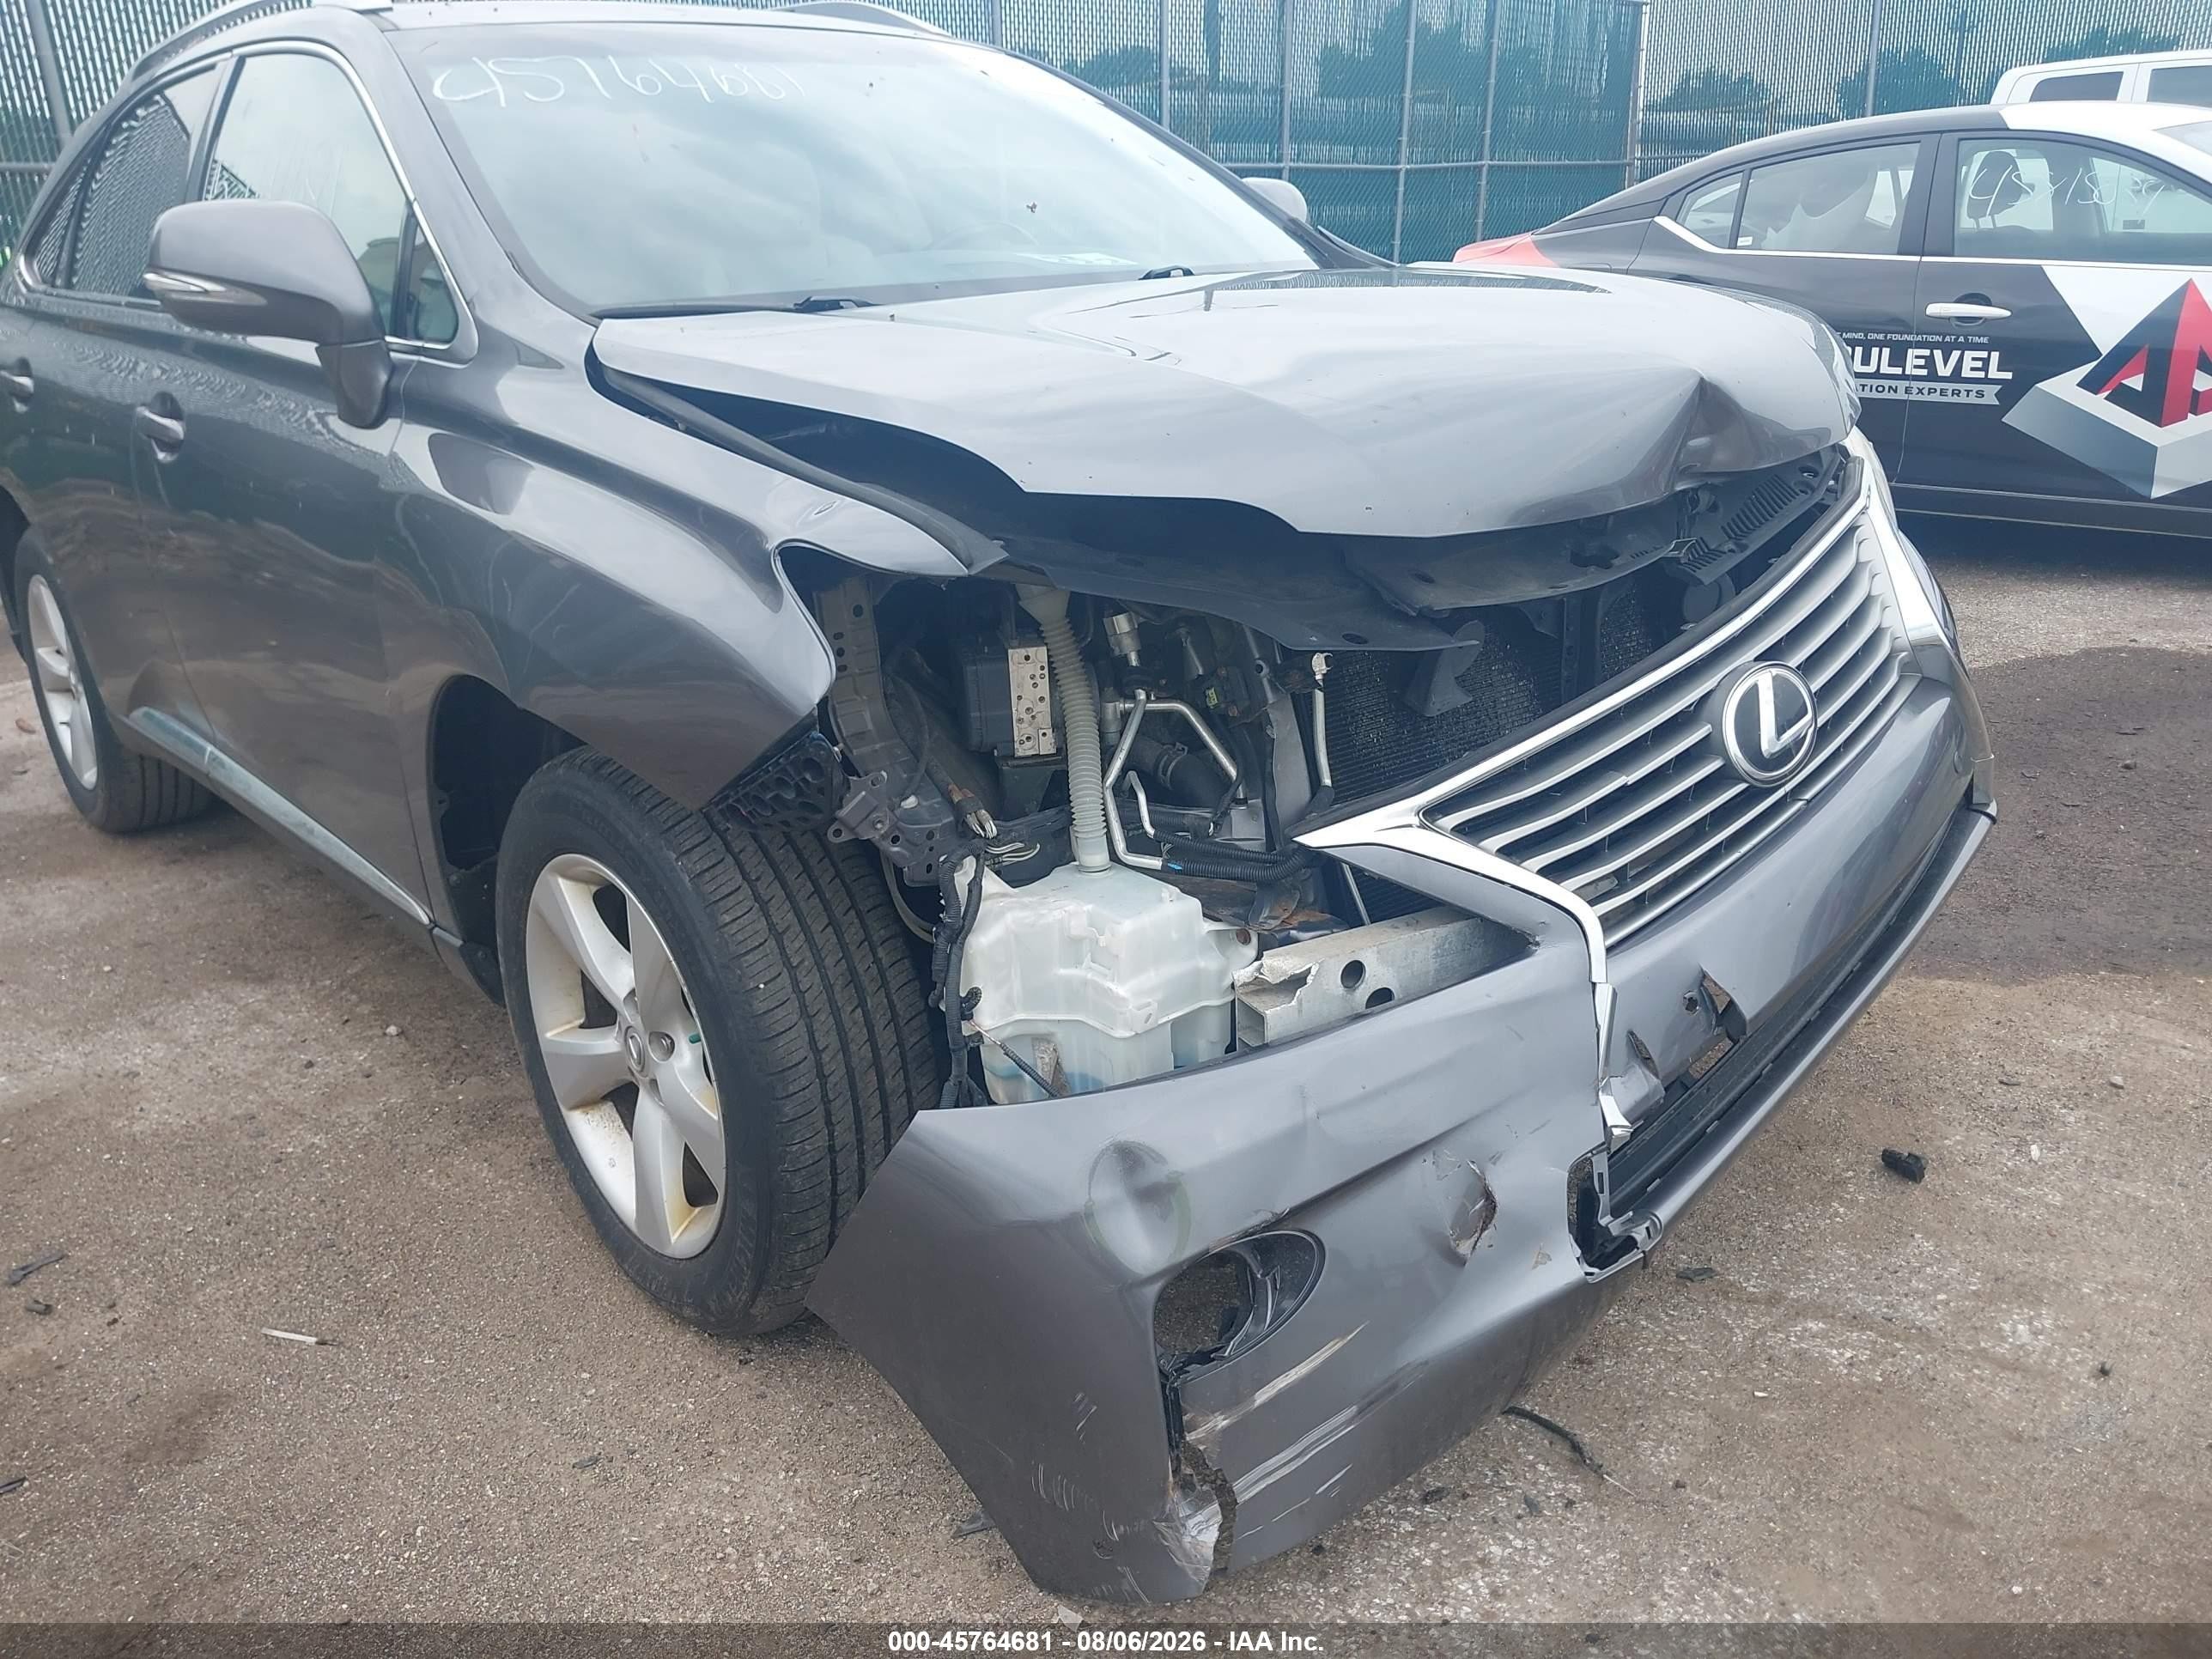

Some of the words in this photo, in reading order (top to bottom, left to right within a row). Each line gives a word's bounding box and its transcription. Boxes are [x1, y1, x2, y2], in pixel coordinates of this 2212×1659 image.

[1842, 332, 1866, 341] MIND,
[1867, 332, 1886, 341] ONE
[1887, 333, 1943, 343] FOUNDATION
[1845, 345, 2014, 380] ULEVEL
[1855, 383, 1899, 395] TION
[1904, 386, 1985, 399] EXPERTS
